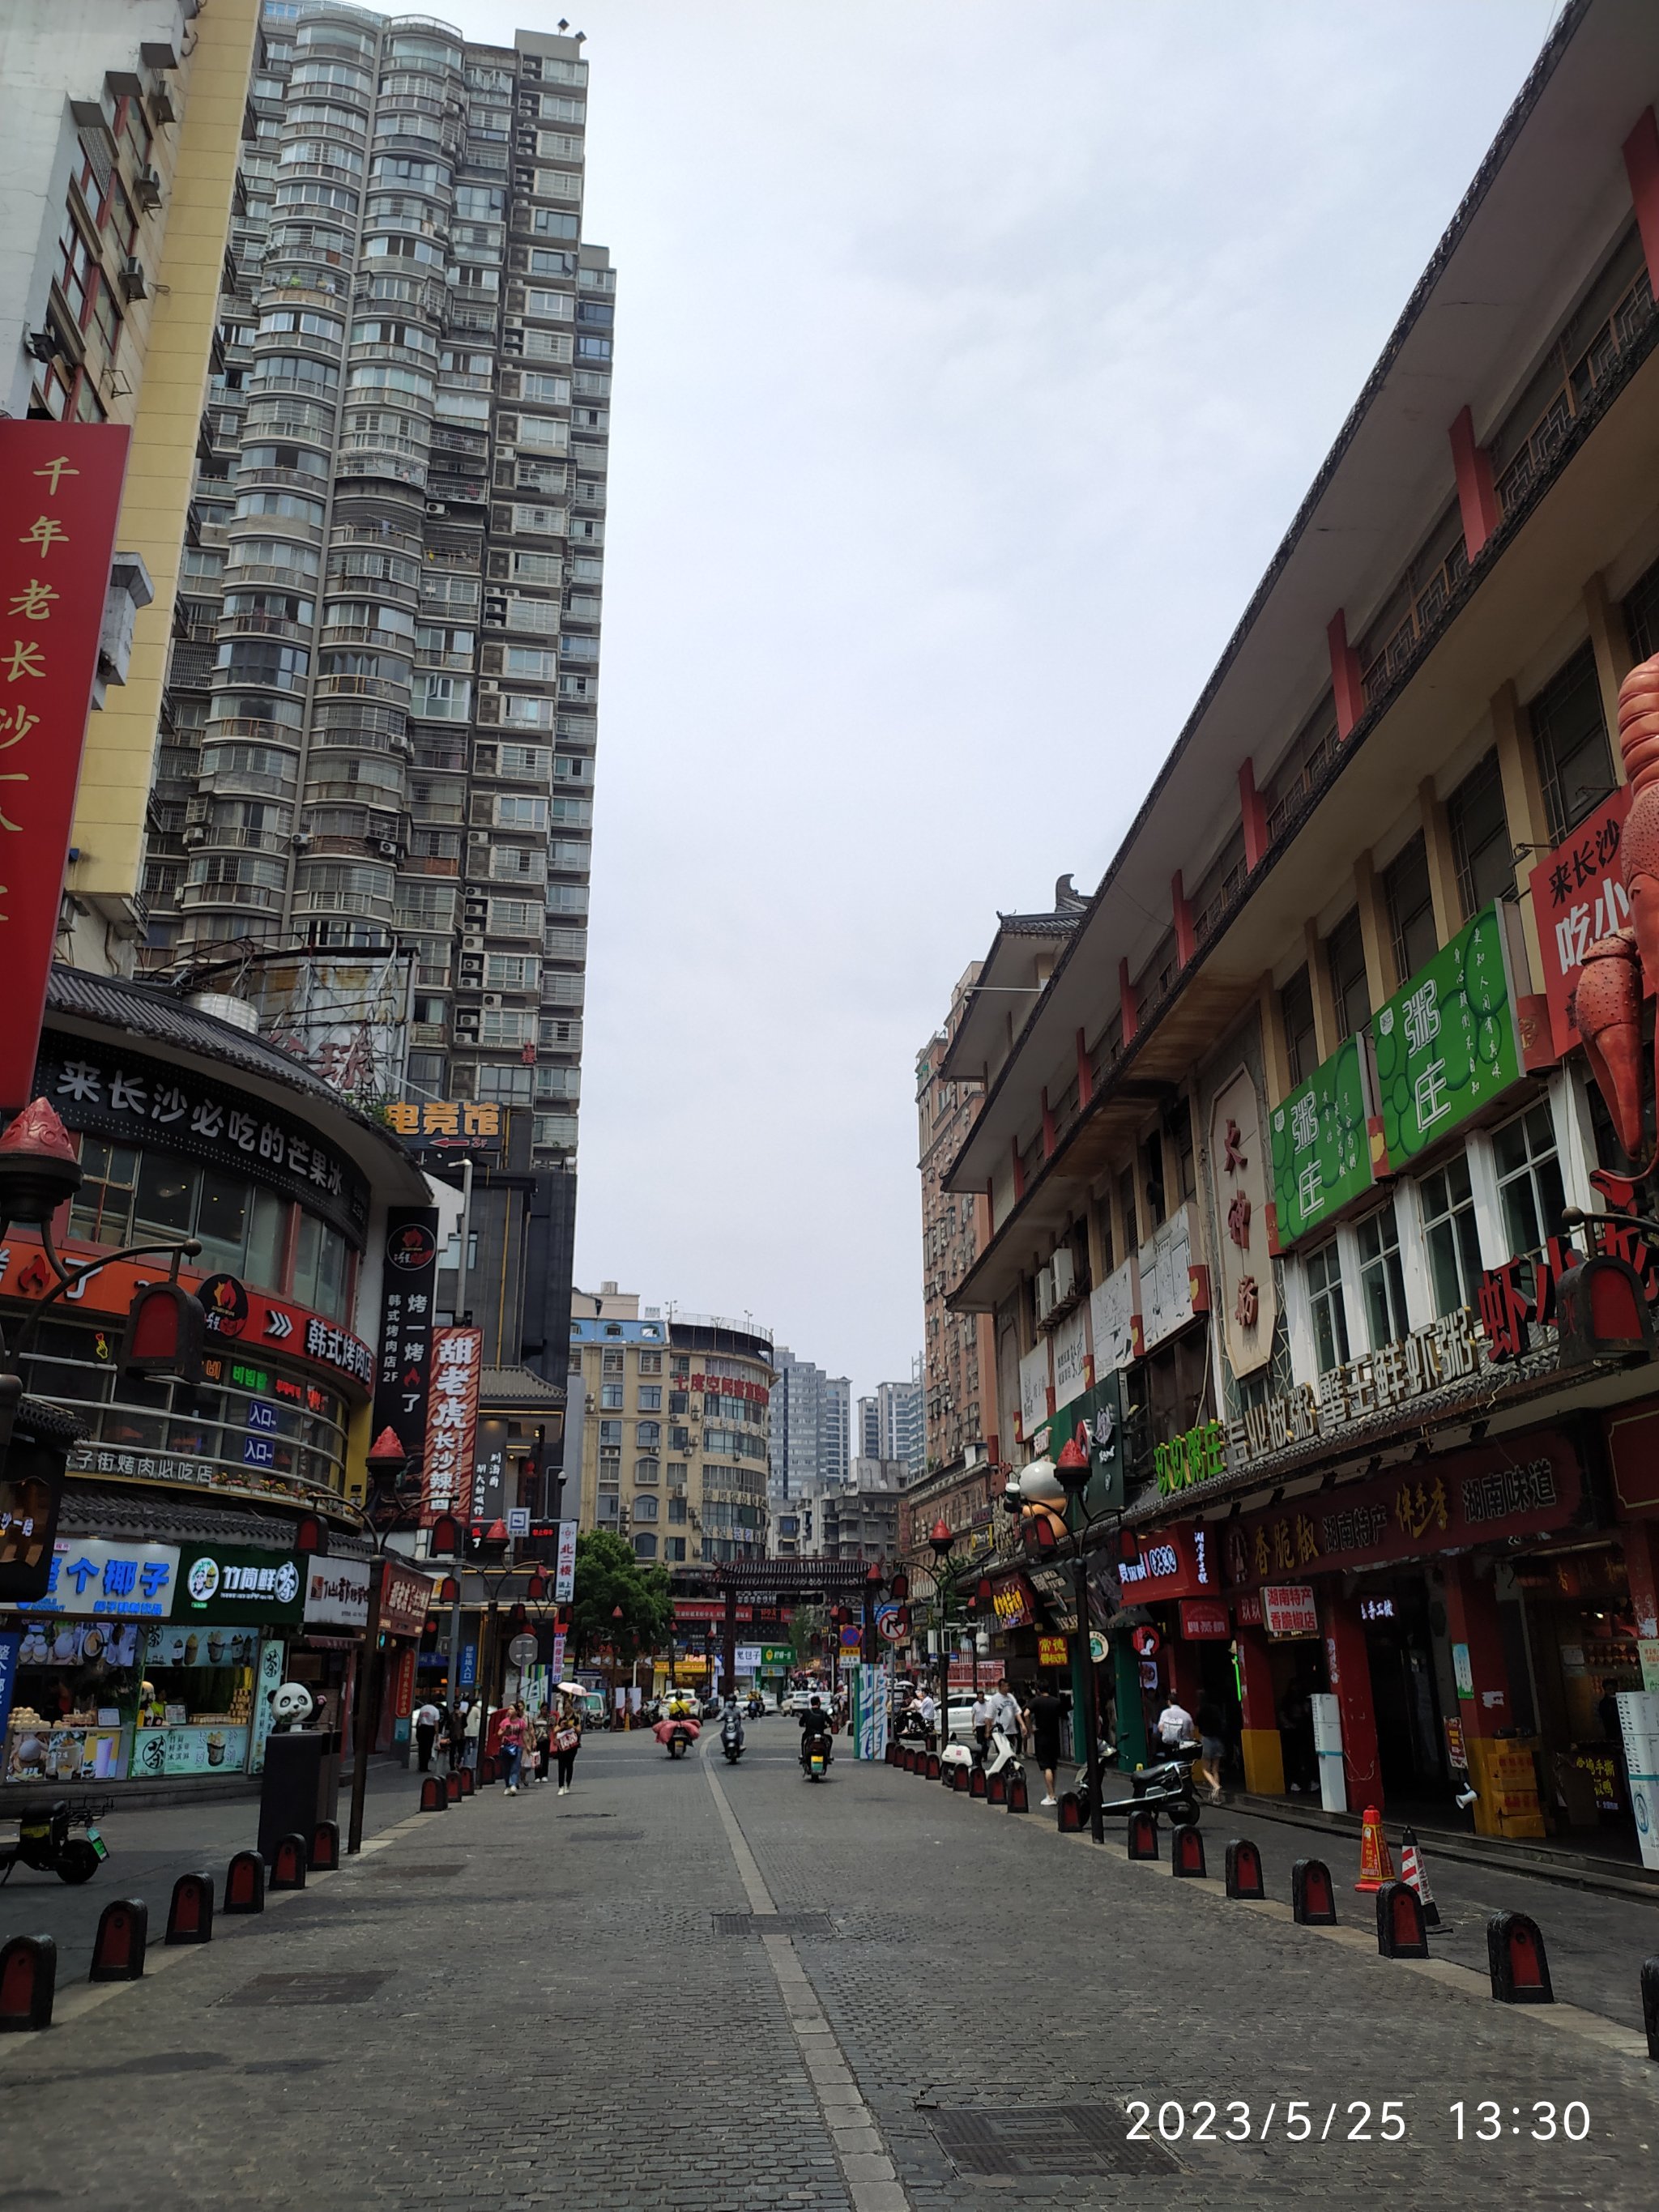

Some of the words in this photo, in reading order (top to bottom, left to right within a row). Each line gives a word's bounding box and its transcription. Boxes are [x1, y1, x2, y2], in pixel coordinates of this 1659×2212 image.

[1402, 978, 1452, 1134] 粥庄
[57, 1059, 343, 1197] 来长沙必吃的芒果冰
[385, 1102, 500, 1136] 电竞馆
[1290, 1090, 1325, 1220] 粥庄
[307, 1318, 373, 1383] 韩式烤肉店
[431, 1338, 474, 1430] 甜老虎
[249, 1406, 272, 1427] 入口
[245, 1442, 267, 1461] 入口
[429, 1432, 455, 1511] 长沙辣酱
[1461, 1458, 1557, 1524] 湖南味道
[1255, 1513, 1320, 1576] 香脆椒
[1322, 1503, 1388, 1554] 湖南特产
[1267, 1588, 1312, 1606] 湖南特产
[1270, 1610, 1316, 1630] 香脆椒店
